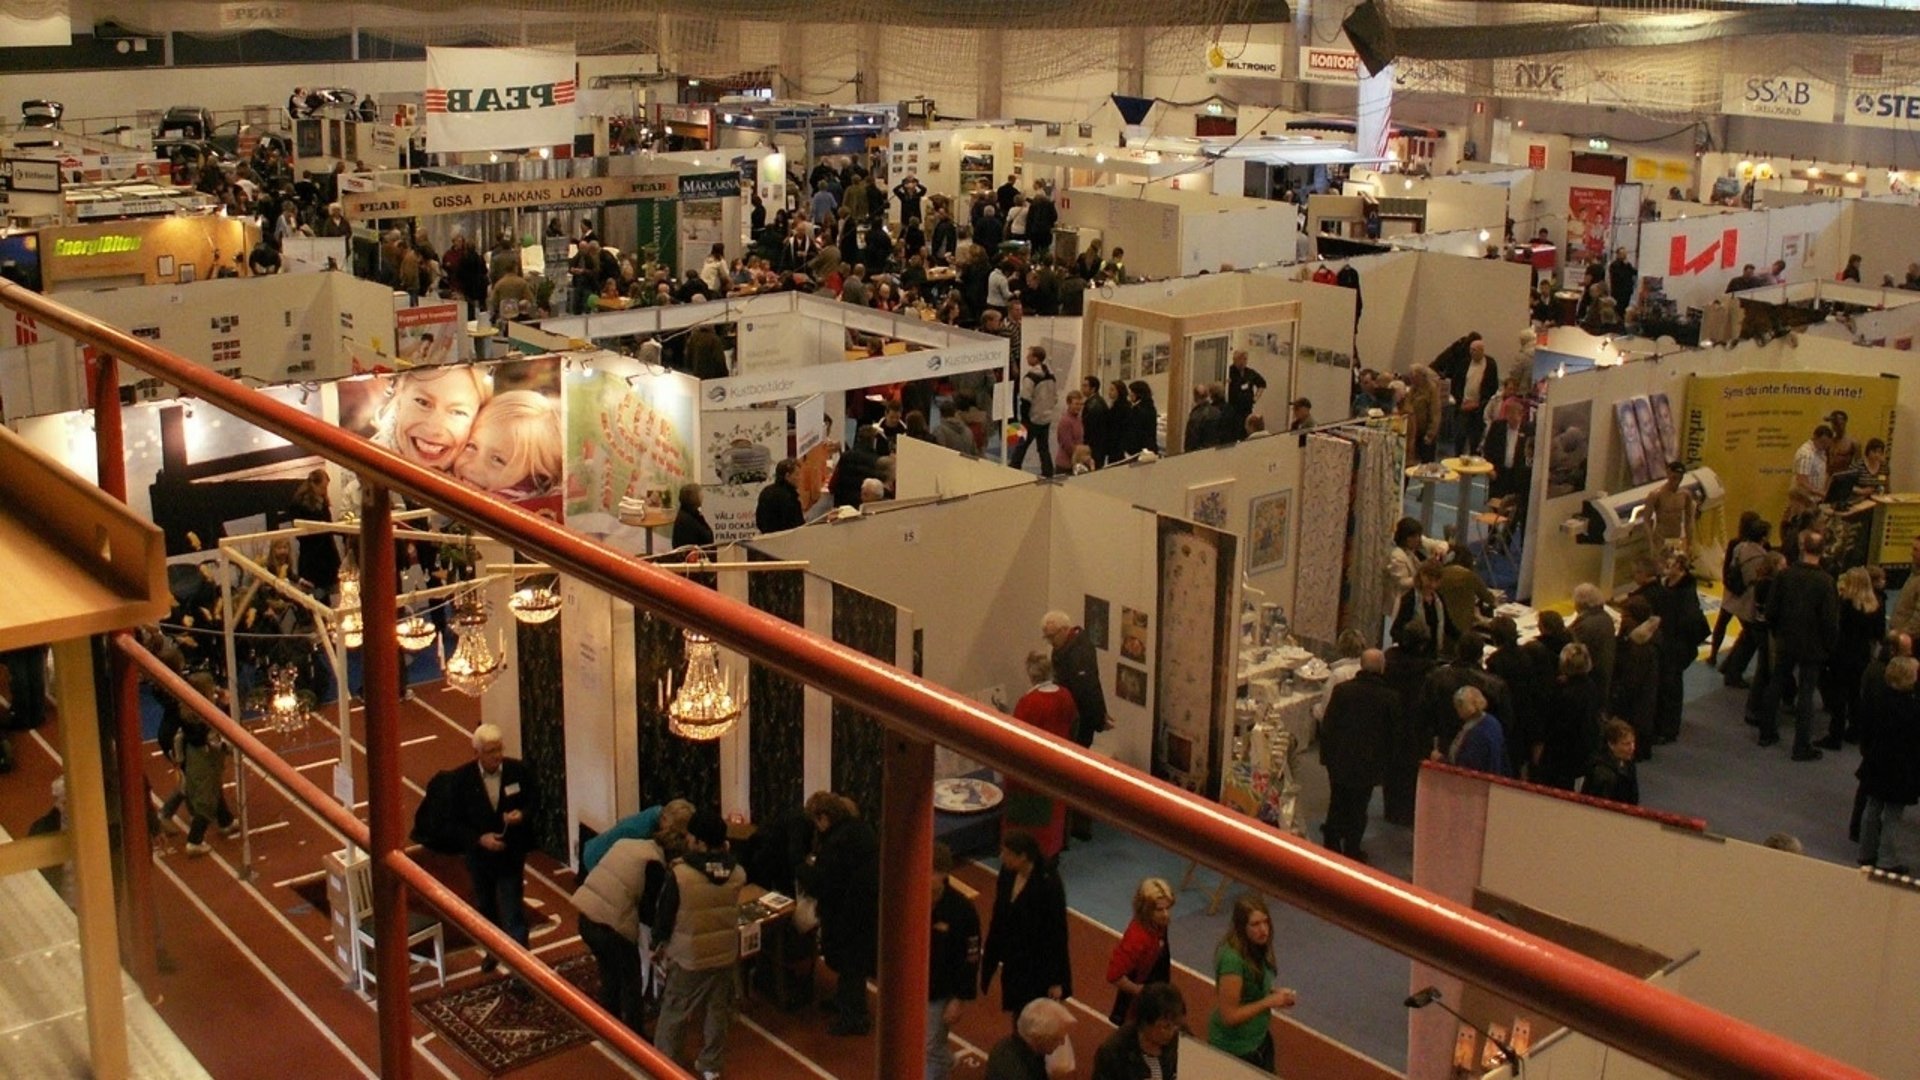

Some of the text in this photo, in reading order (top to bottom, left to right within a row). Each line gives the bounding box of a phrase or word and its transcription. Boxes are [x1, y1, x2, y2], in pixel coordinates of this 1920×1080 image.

[1745, 78, 1811, 106] SSAB
[631, 183, 666, 193] PEAB
[432, 195, 473, 208] GISSA
[482, 188, 551, 205] PLANKANS
[359, 201, 401, 212] PEAB
[1745, 386, 1757, 396] du
[1758, 384, 1780, 396] inte
[1782, 383, 1812, 395] finns
[1814, 384, 1831, 396] du
[1833, 387, 1863, 399] inte!
[715, 522, 727, 530] DU
